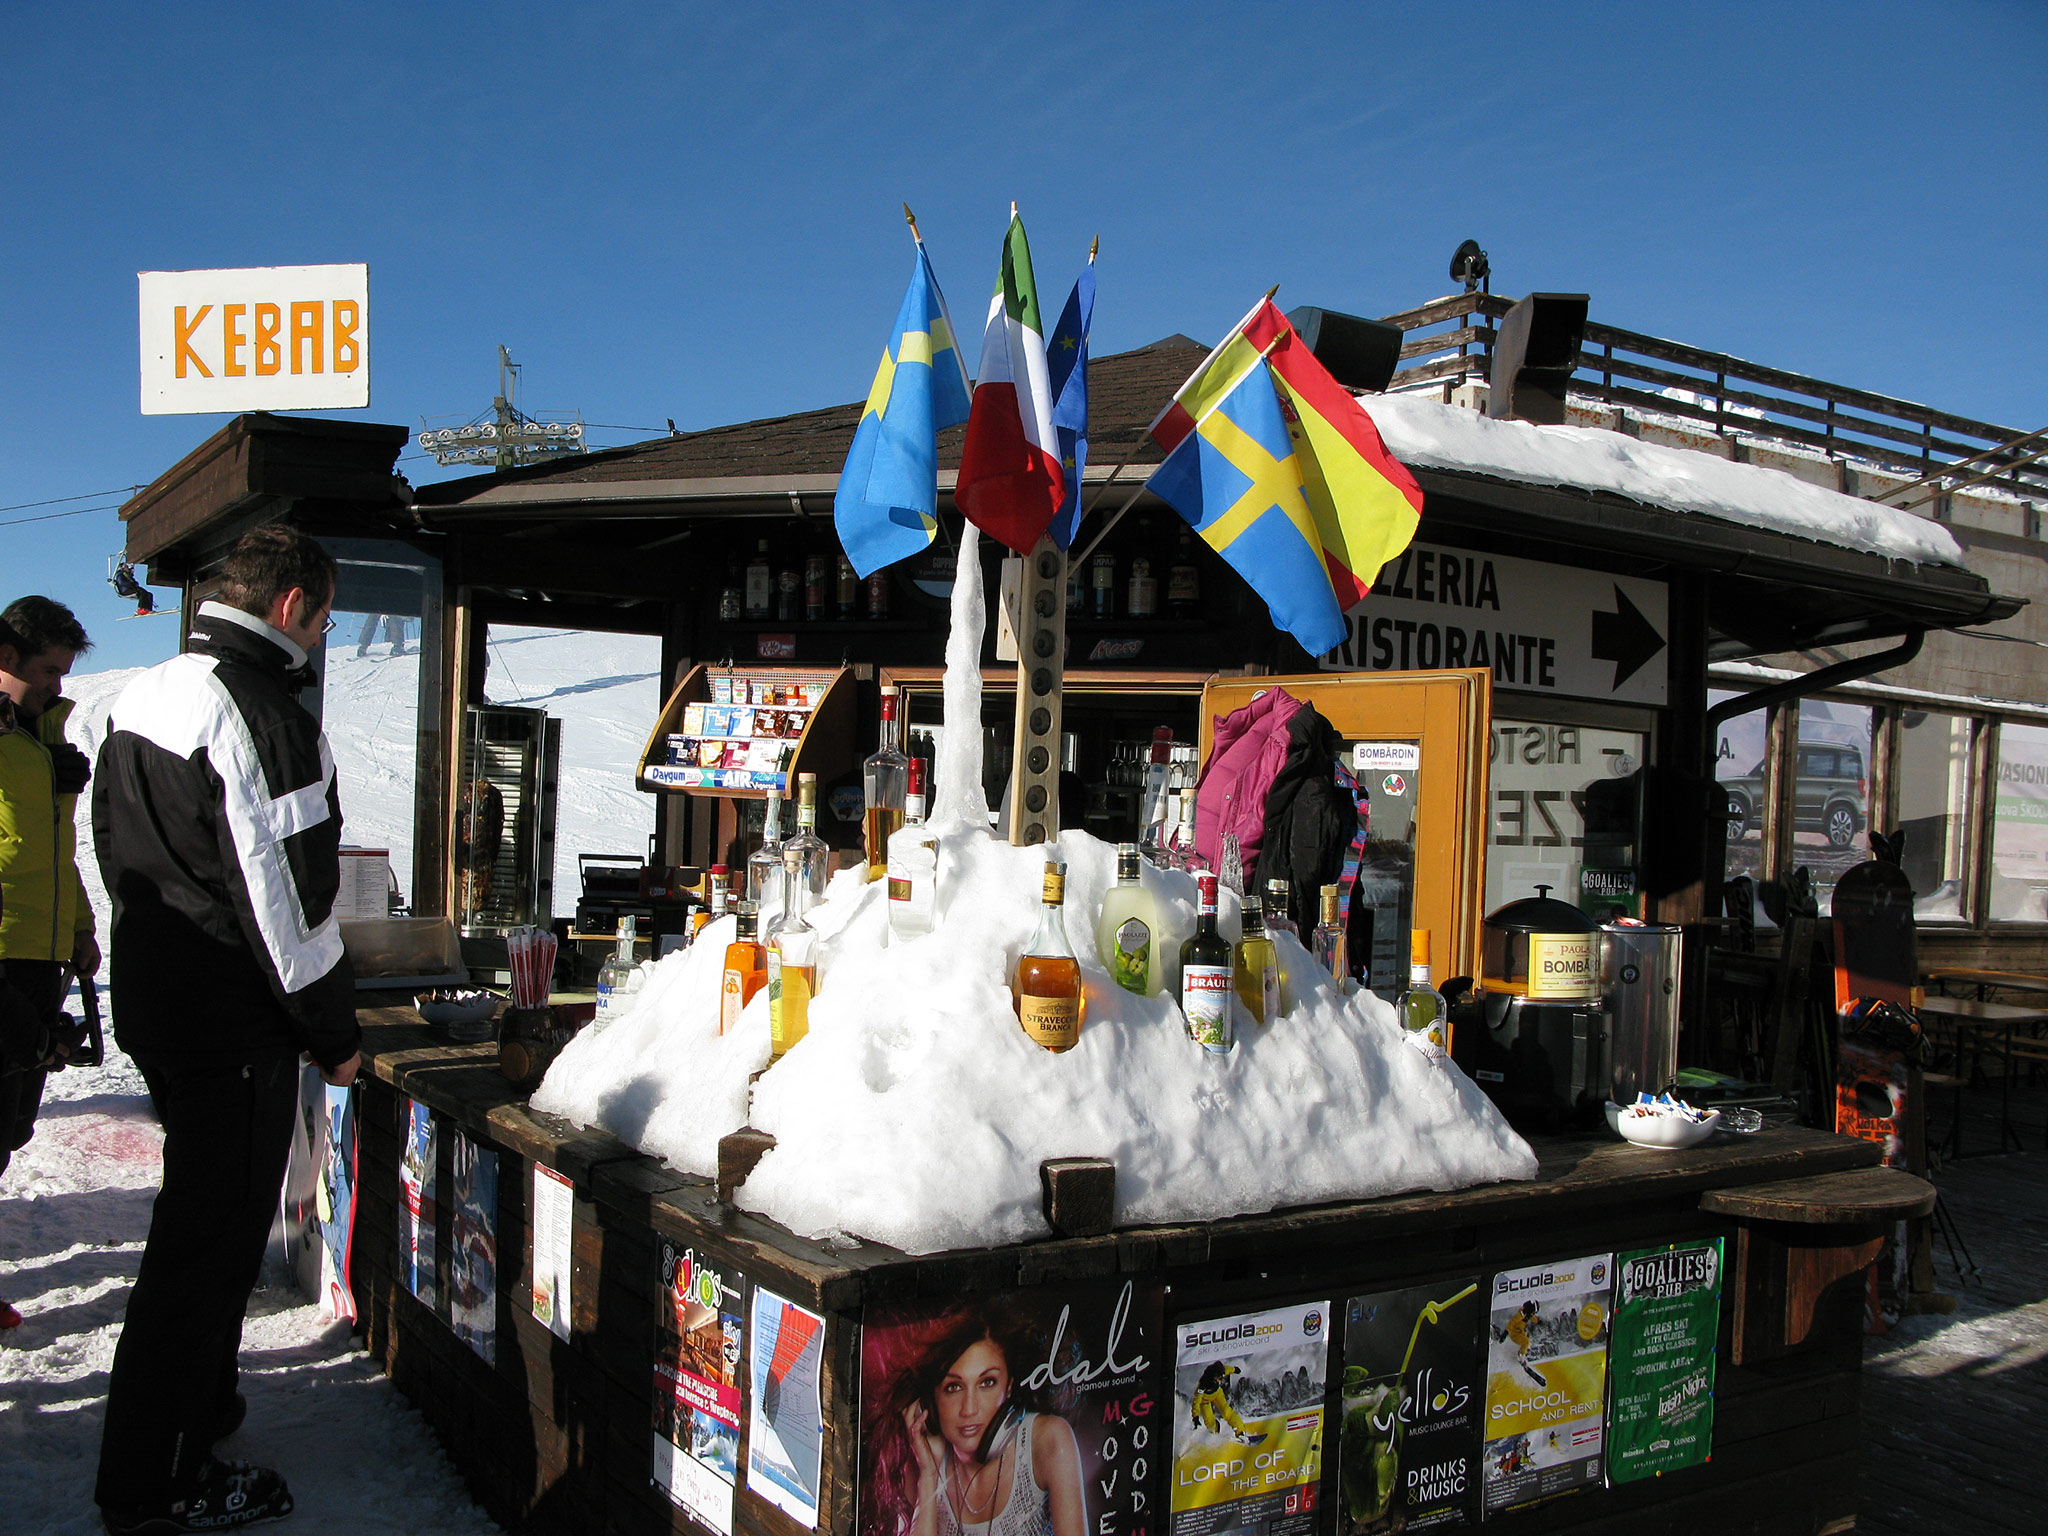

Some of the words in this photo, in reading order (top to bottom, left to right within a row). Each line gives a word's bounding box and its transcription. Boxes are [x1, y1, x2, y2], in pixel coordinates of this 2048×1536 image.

[175, 299, 359, 379] KEBAB
[1329, 613, 1555, 687] RISTORANTE
[652, 767, 686, 783] Daygum
[722, 770, 752, 788] AIR
[1040, 1023, 1071, 1032] BRANCA
[1528, 1285, 1565, 1296] snowboard
[1657, 1282, 1682, 1299] PUB
[1352, 1304, 1378, 1322] sky
[1020, 1280, 1150, 1391] dali
[1643, 1321, 1672, 1336] APRES
[1674, 1318, 1689, 1330] SKI
[1663, 1330, 1685, 1341] OLDIES
[1198, 1346, 1210, 1356] ski
[1222, 1336, 1270, 1351] snowboard
[1633, 1347, 1646, 1357] AND
[1647, 1343, 1664, 1354] ROCK
[683, 1373, 691, 1389] THE
[692, 1379, 718, 1402] PLEASURE
[1076, 1379, 1110, 1394] glamour
[1112, 1374, 1136, 1387] sound
[685, 1389, 704, 1408] terrace
[710, 1400, 736, 1423] fireplace
[1491, 1390, 1571, 1420] SCHOOL
[1618, 1396, 1633, 1407] OPEN
[1634, 1392, 1651, 1404] DAILY
[1658, 1390, 1681, 1417] Irish
[1682, 1375, 1708, 1400] Night
[1540, 1409, 1565, 1422] AND
[1570, 1400, 1599, 1415] RENT
[1409, 1424, 1429, 1437] MUSIC
[1430, 1419, 1454, 1432] LOUNGE
[1455, 1416, 1468, 1425] BAR
[1623, 1448, 1645, 1458] Heineken
[1180, 1459, 1245, 1486] LORD
[1254, 1449, 1286, 1470] OF
[1408, 1457, 1466, 1488] DRINKS
[1231, 1476, 1258, 1492] THE
[1265, 1464, 1316, 1485] BOARD
